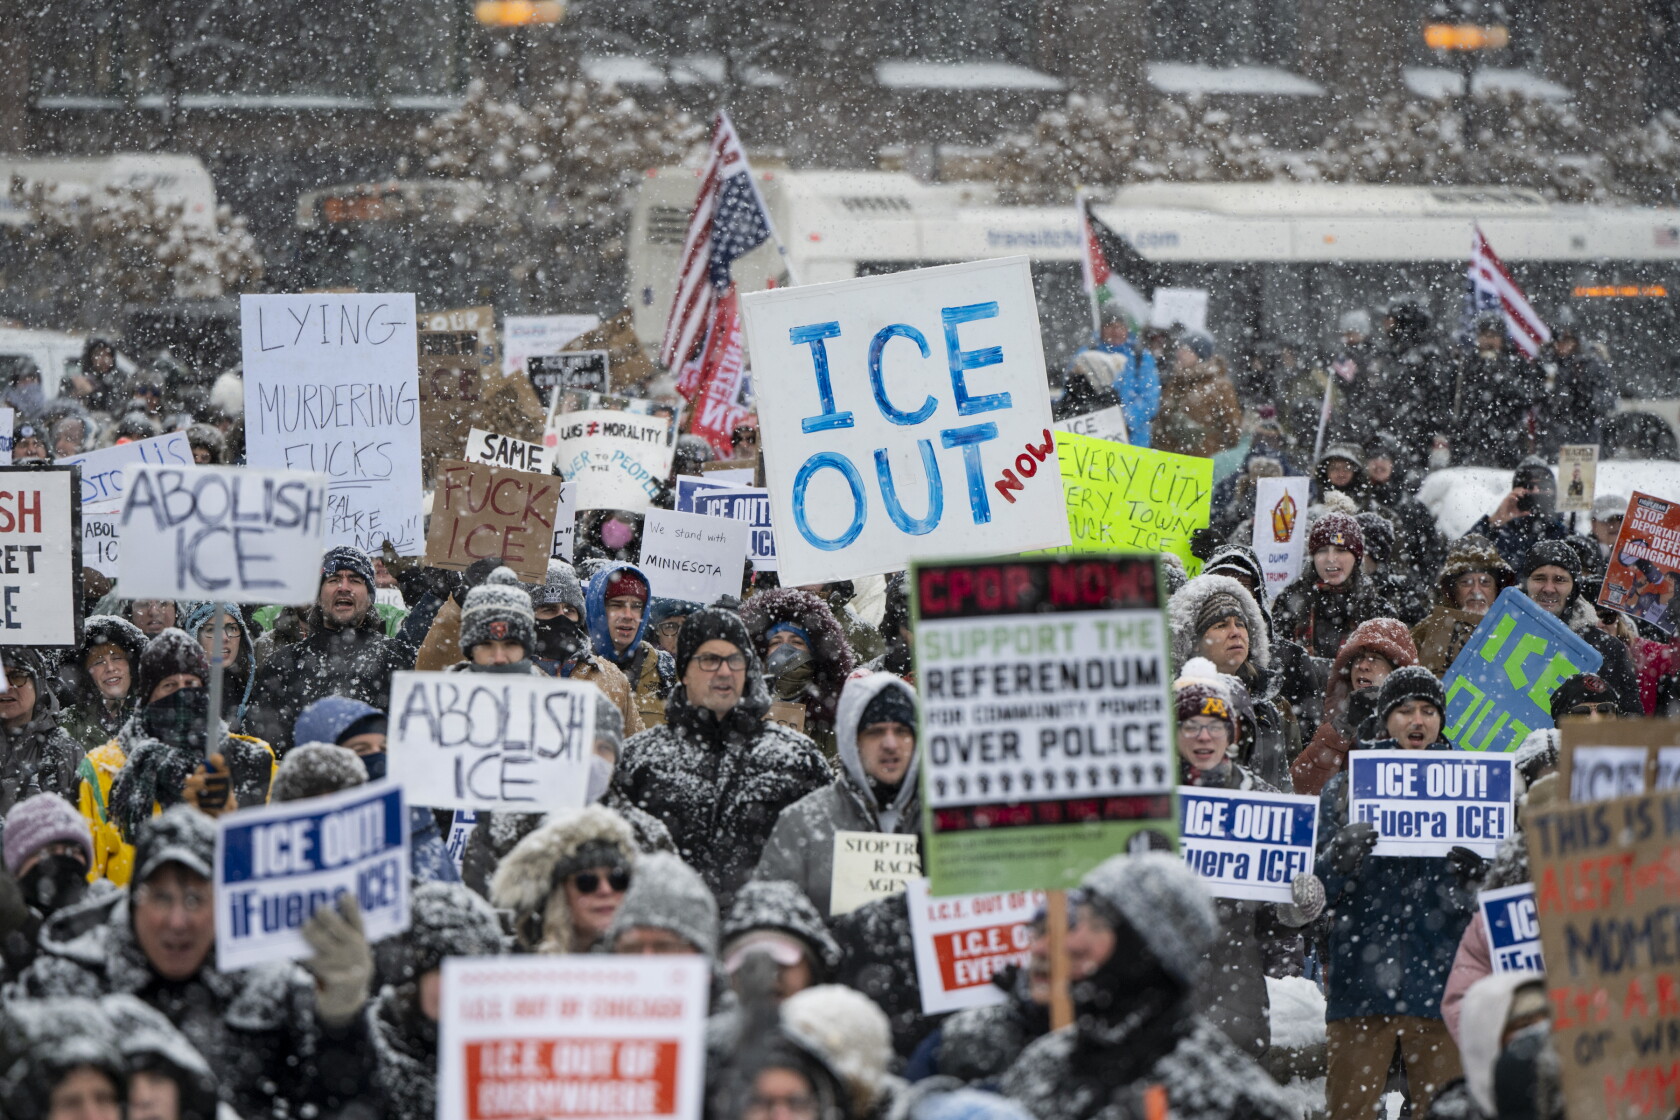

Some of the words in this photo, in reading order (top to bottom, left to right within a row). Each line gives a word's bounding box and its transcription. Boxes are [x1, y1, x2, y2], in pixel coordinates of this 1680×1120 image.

[259, 304, 407, 351] LYING
[789, 301, 1012, 434] ICE
[258, 382, 417, 435] MURDERING
[480, 434, 544, 469] SAME
[603, 423, 662, 444] MORALITY
[285, 441, 392, 477] FUCKS
[610, 450, 661, 499] PEOPLE
[995, 429, 1054, 504] NOW
[1058, 442, 1140, 500] EVERY
[120, 468, 325, 538] ABOLISH
[445, 467, 551, 528] FUCK
[791, 421, 999, 551] OUT
[707, 499, 729, 517] ICE
[733, 498, 772, 524] OUT
[1063, 483, 1113, 518] ERY
[1126, 500, 1196, 536] TOWN
[1634, 506, 1665, 524] STOP
[448, 518, 529, 563] ICE
[650, 521, 665, 535] We
[674, 529, 703, 541] stand
[707, 531, 727, 544] with
[1069, 515, 1115, 544] UCK
[1127, 525, 1177, 551] ICE
[176, 526, 288, 591] ICE
[645, 554, 722, 577] MINNESOTA
[1265, 572, 1289, 582] TRUMP
[1268, 552, 1289, 564] DUMP
[1623, 541, 1680, 570] IMMIGRAN
[924, 622, 1075, 661] SUPPORT
[1094, 618, 1157, 650] THE
[926, 657, 1160, 699] REFERENDUM
[1480, 613, 1581, 716] ICE
[398, 681, 586, 763] ABOLISH
[929, 706, 961, 725] FOR
[972, 700, 1087, 723] COMMUNITY
[1099, 696, 1161, 715] POWER
[1442, 674, 1533, 752] OUT
[930, 729, 1020, 768] OVER
[454, 752, 539, 802] ICE
[1376, 762, 1418, 797] ICE
[1426, 763, 1488, 798] OUT!
[251, 819, 315, 878] ICE
[320, 799, 385, 868] OUT!
[1184, 800, 1229, 837] ICE
[1233, 803, 1294, 845] OUT!
[1456, 805, 1505, 840] ICE!
[1534, 802, 1611, 859] THIS
[845, 838, 889, 854] STOP
[892, 840, 917, 856] TR
[971, 894, 1003, 915] OUT
[1008, 891, 1027, 909] OF
[1507, 898, 1541, 941] IC
[951, 928, 1008, 958] I.C.E.
[1565, 906, 1680, 977] MOME
